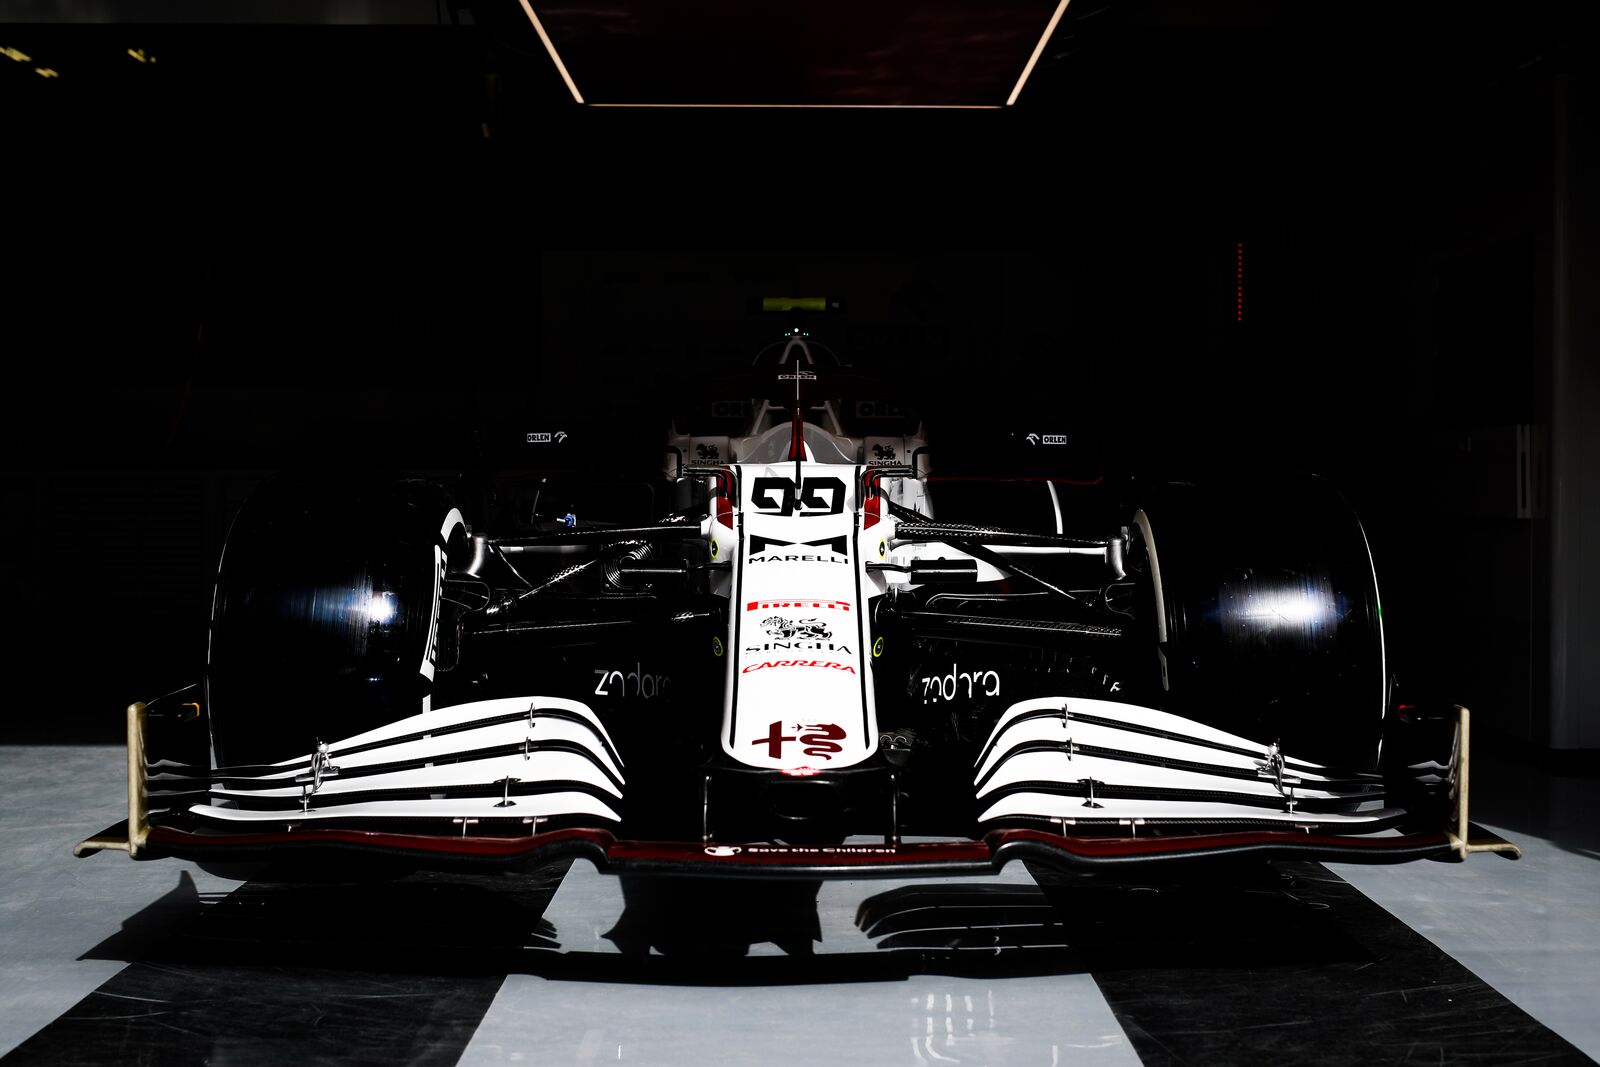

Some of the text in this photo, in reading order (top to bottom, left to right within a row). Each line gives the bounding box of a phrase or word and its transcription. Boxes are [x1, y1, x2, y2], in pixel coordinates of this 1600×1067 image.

[527, 433, 551, 442] ORLEN
[1043, 435, 1067, 443] ORLEN
[751, 477, 846, 516] 99
[749, 554, 848, 564] MARELLI
[745, 642, 852, 656] SINGHA
[742, 660, 856, 674] CARRERA
